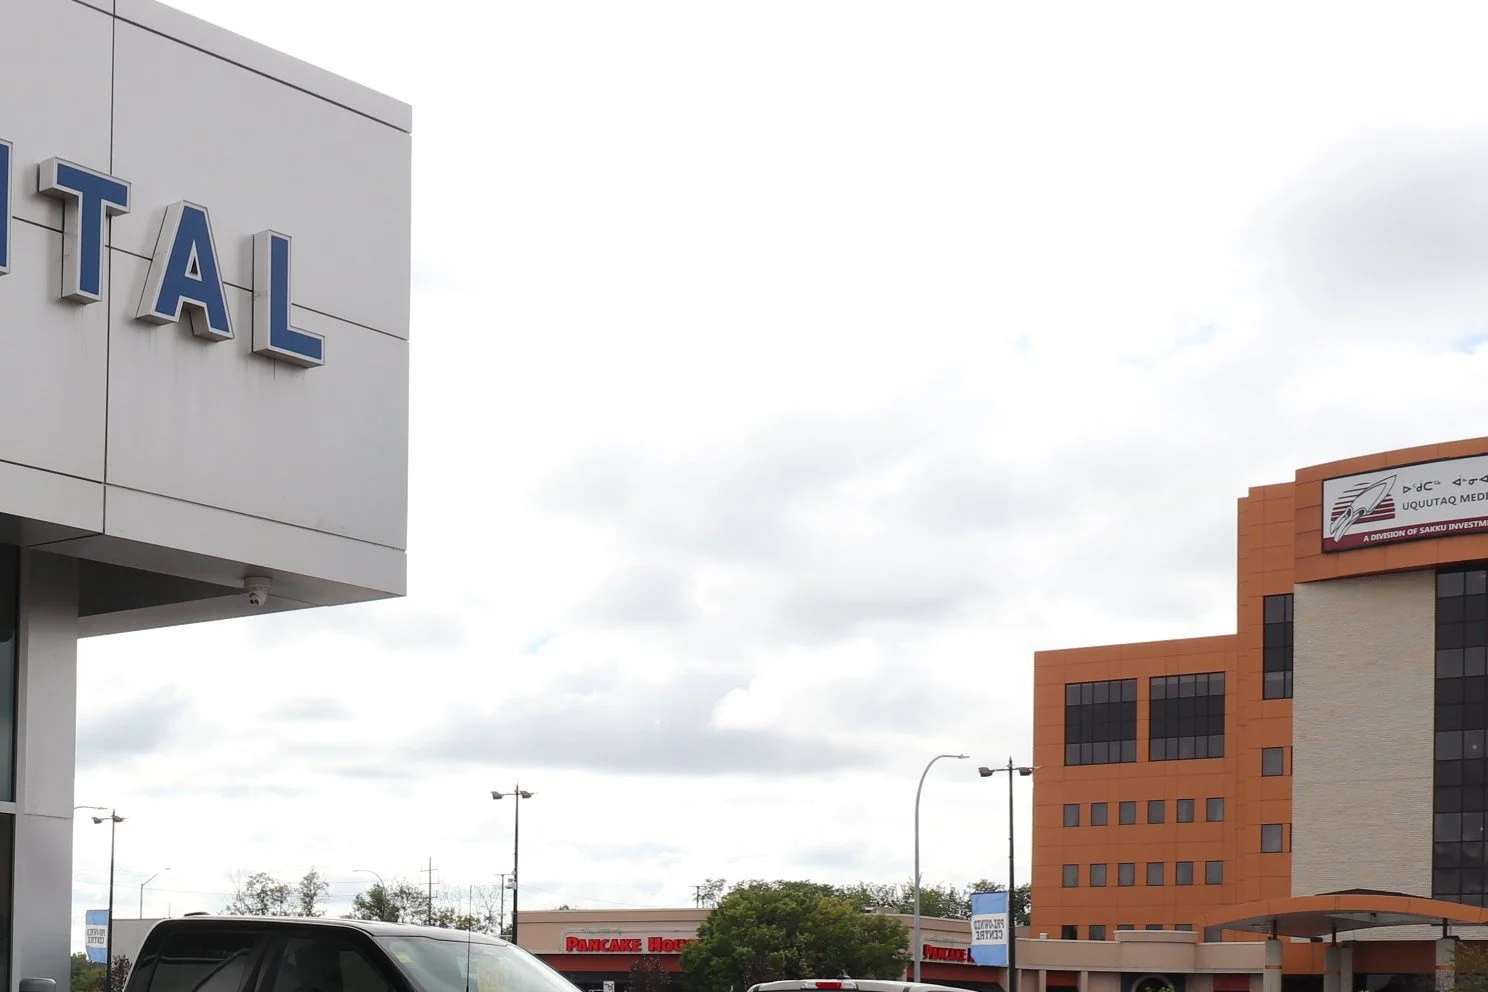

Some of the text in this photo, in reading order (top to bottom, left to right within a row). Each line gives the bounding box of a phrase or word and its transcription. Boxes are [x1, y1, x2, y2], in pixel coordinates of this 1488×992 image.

[1402, 495, 1457, 510] UQUUTAQ
[1370, 530, 1406, 541] DIVISION
[1407, 528, 1418, 536] OF
[1419, 524, 1447, 534] SAKKU
[566, 937, 642, 952] PANCAKE
